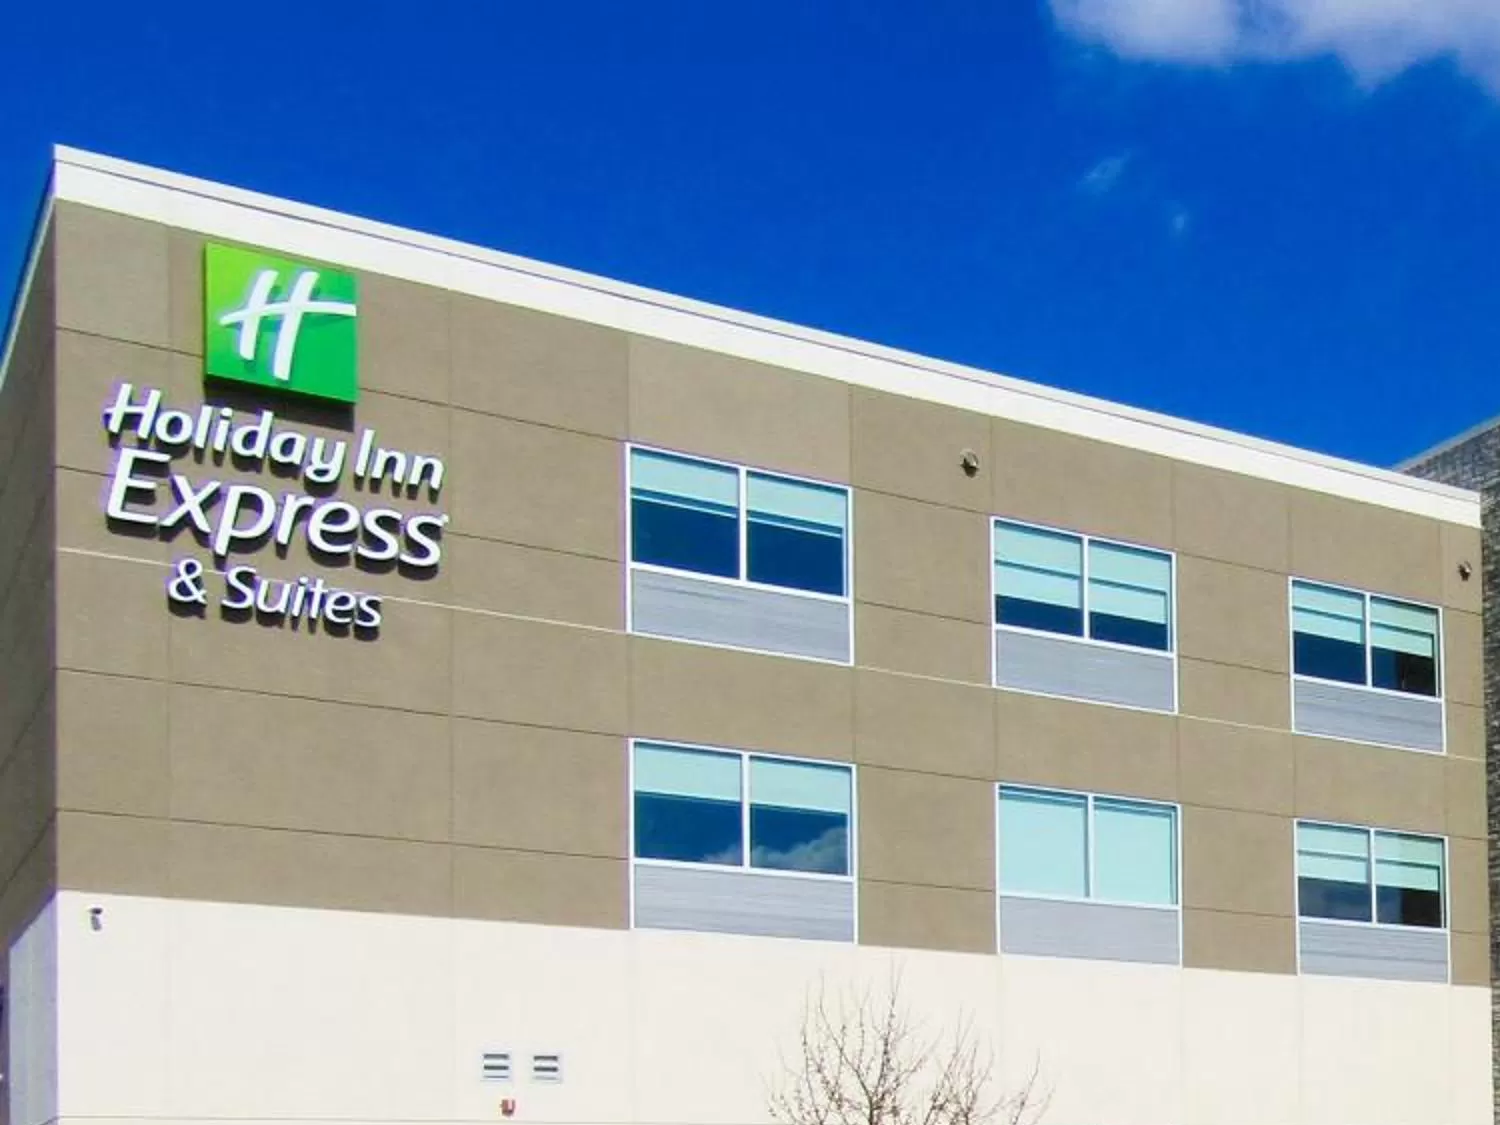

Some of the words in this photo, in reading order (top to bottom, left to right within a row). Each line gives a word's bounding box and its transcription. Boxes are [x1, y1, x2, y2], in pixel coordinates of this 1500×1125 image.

[103, 383, 346, 482] Holiday
[354, 429, 443, 490] Inn
[106, 447, 443, 566] Express
[168, 558, 206, 603] &
[221, 566, 382, 628] Suites
